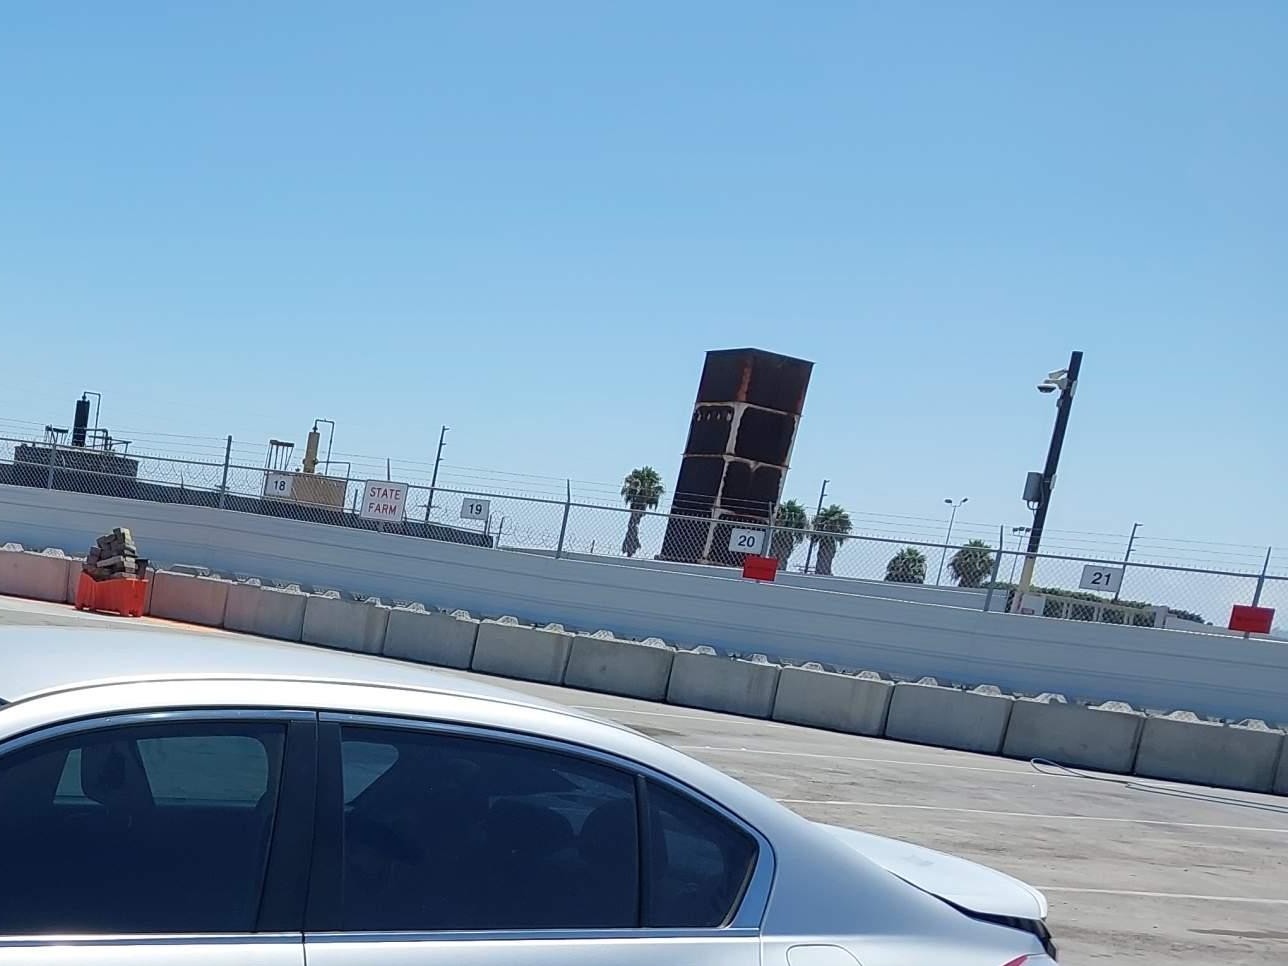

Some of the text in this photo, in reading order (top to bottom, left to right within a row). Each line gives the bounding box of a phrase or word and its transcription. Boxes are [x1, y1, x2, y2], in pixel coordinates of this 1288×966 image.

[273, 480, 286, 491] 18
[369, 487, 401, 500] STATE
[368, 503, 397, 516] FARM
[468, 504, 482, 515] 19
[737, 535, 755, 548] 20
[1091, 572, 1112, 585] 21
